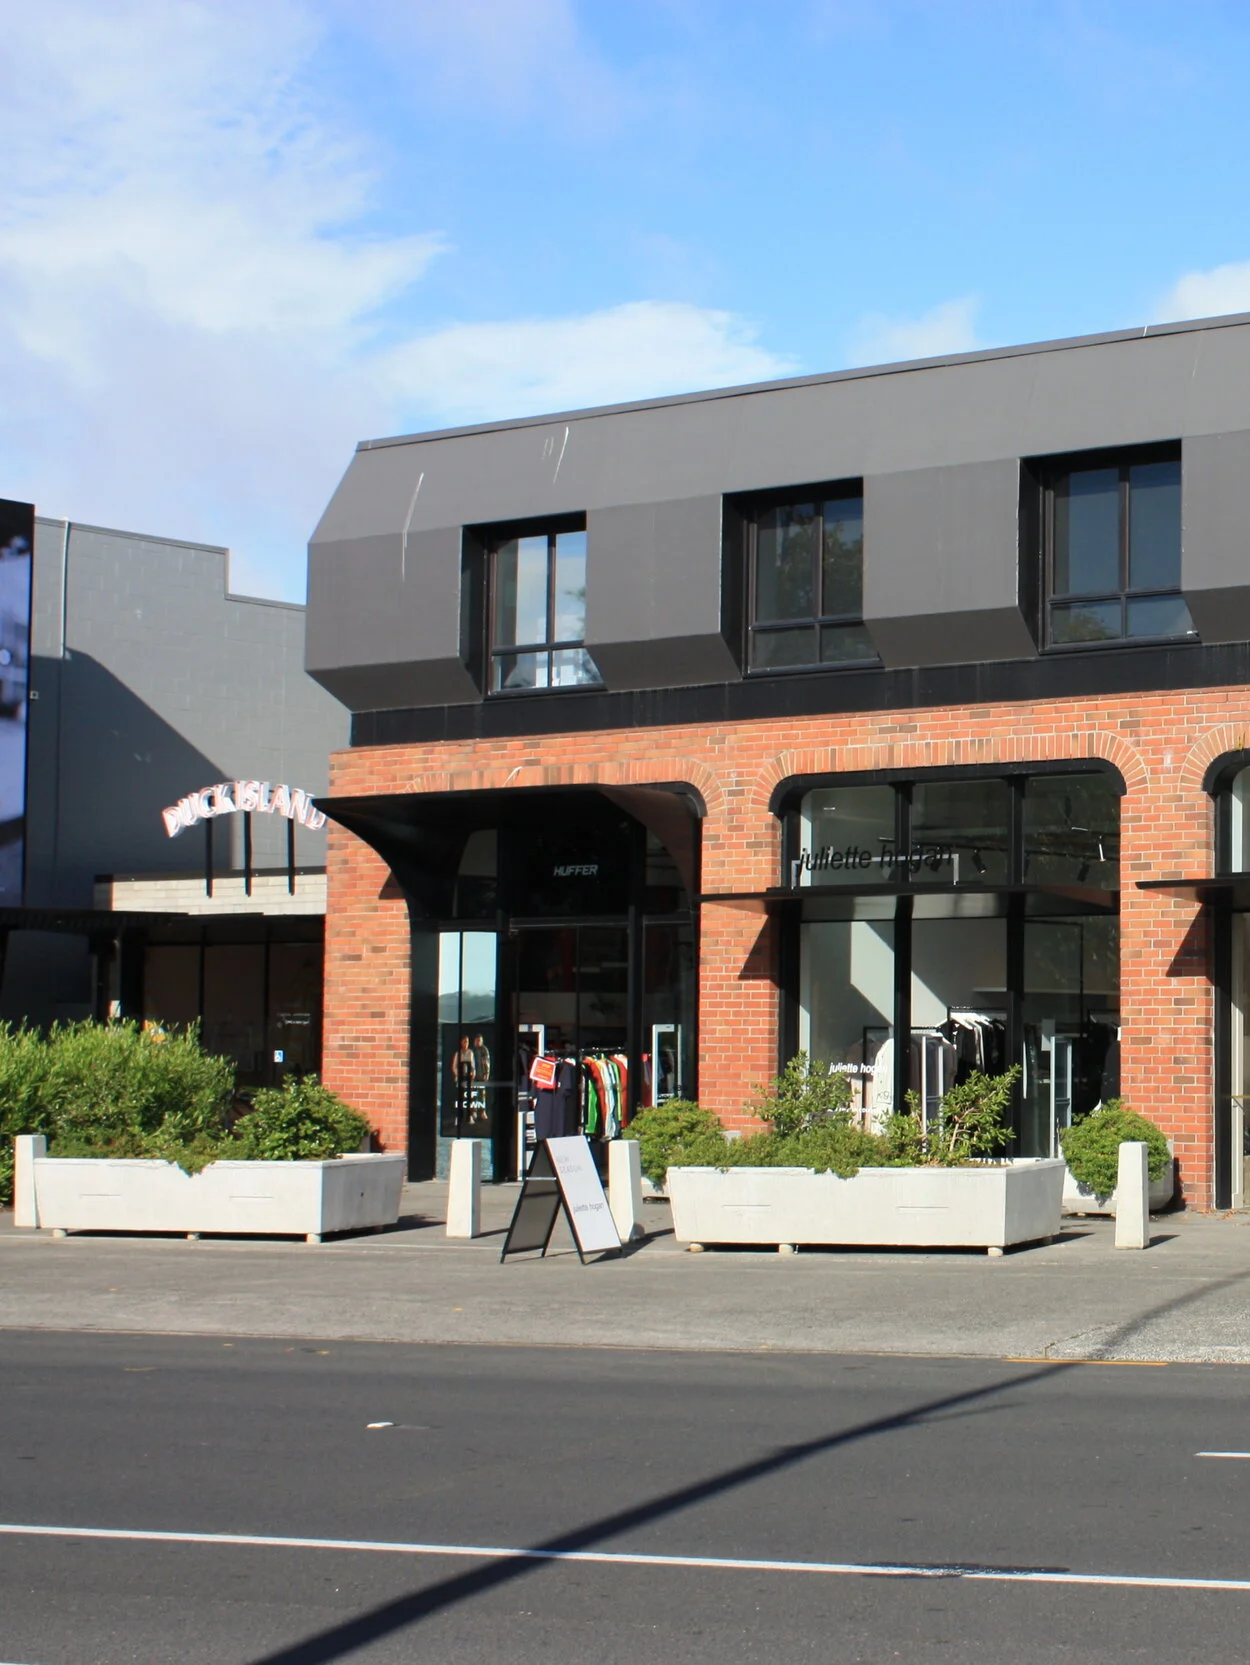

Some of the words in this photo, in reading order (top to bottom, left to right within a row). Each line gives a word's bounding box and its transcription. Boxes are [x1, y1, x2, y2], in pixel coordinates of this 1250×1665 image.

[161, 784, 237, 838] DUCK
[234, 780, 327, 831] ISLAND
[553, 864, 599, 877] HUFFER
[797, 845, 872, 878] juliette
